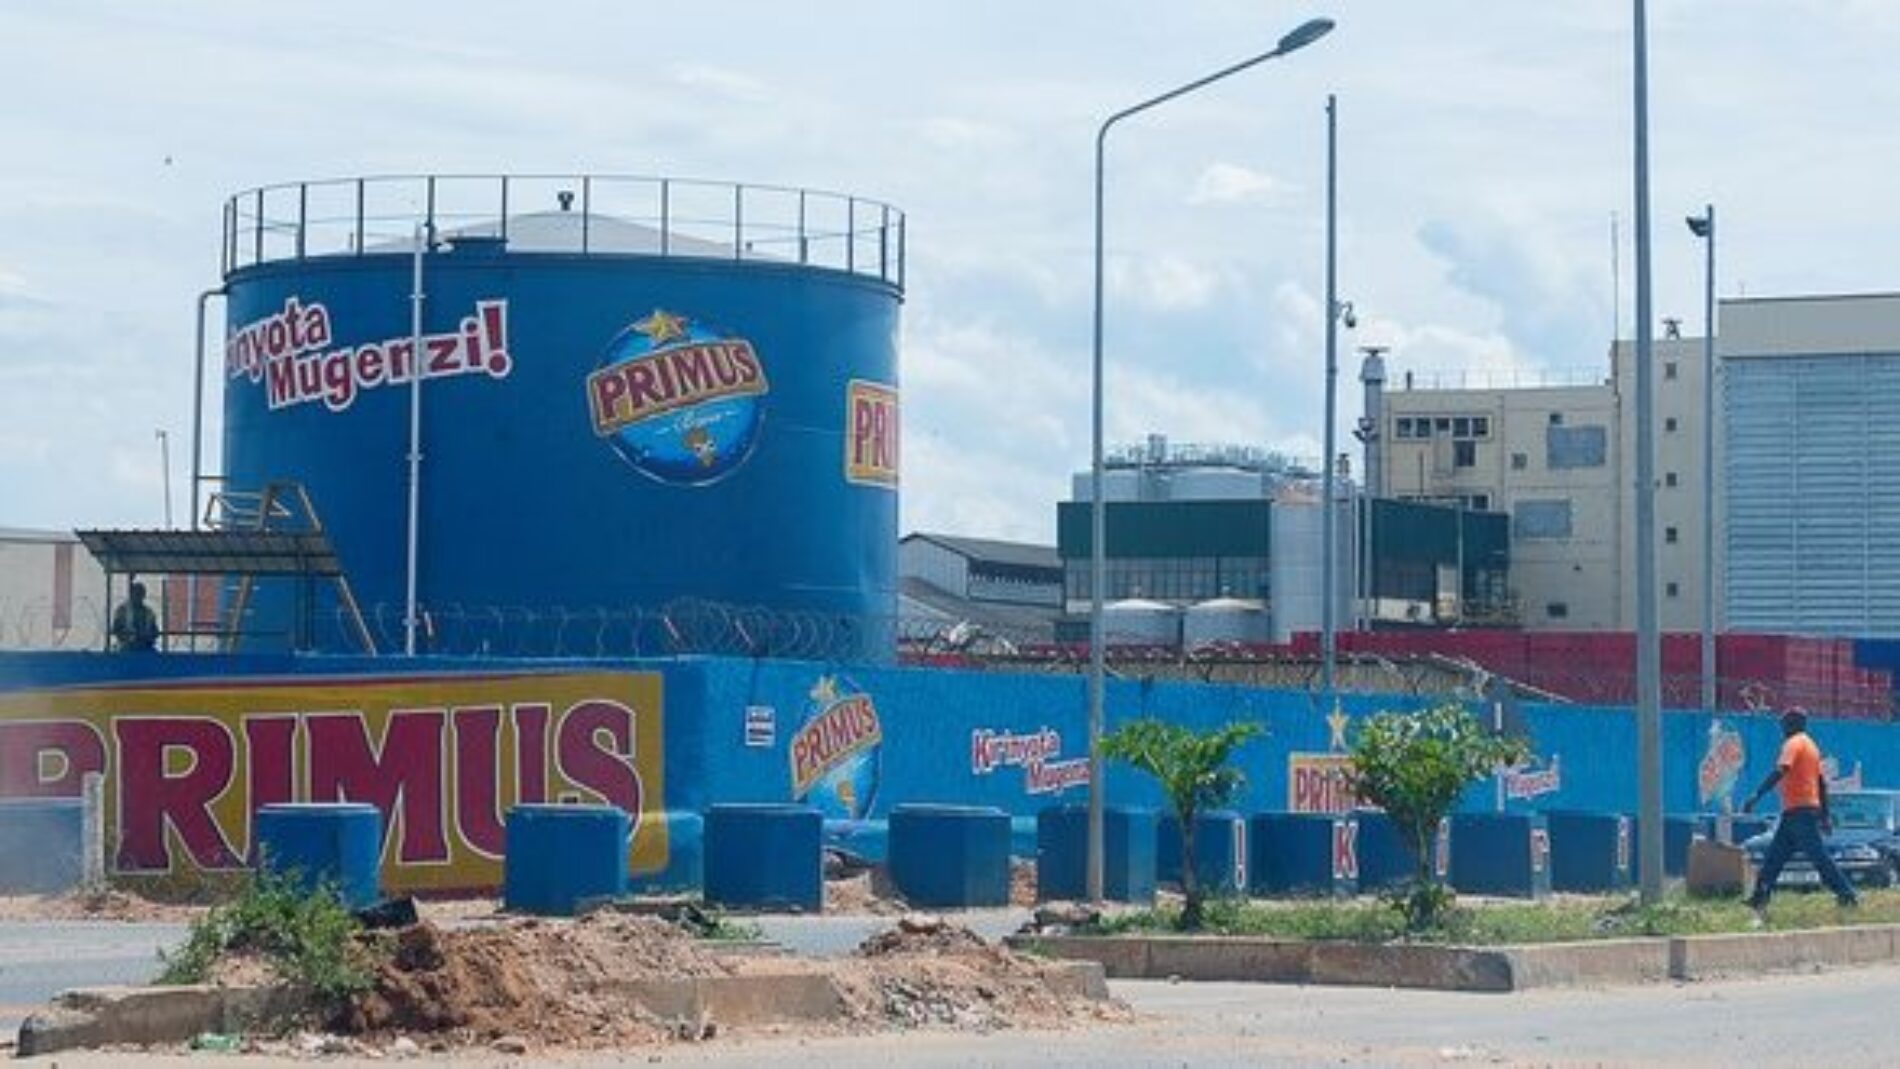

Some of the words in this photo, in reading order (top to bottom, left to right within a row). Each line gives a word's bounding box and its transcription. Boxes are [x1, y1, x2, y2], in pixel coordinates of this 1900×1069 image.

[268, 300, 511, 410] Mugenzi!
[594, 344, 758, 421] PRIMUS
[793, 699, 877, 783] PRIMUS
[1332, 820, 1359, 879] K
